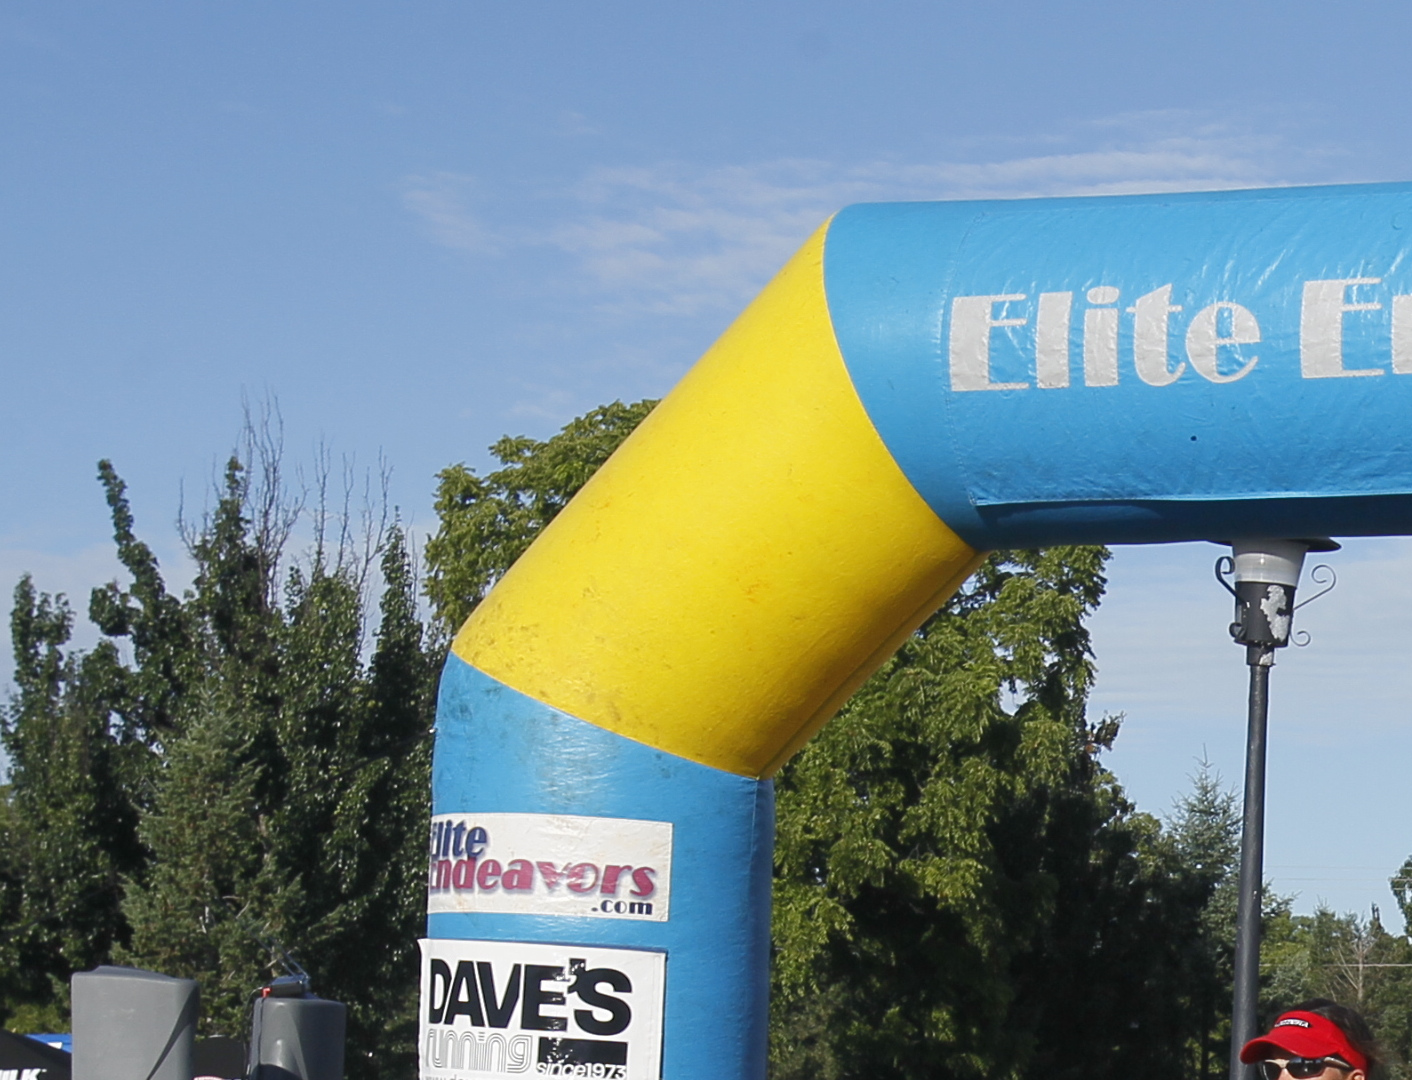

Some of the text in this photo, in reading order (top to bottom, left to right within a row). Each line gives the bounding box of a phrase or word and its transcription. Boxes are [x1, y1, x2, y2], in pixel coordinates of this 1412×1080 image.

[949, 284, 1261, 392] Elite
[591, 899, 653, 915] .com
[429, 958, 633, 1036] DAVE'S
